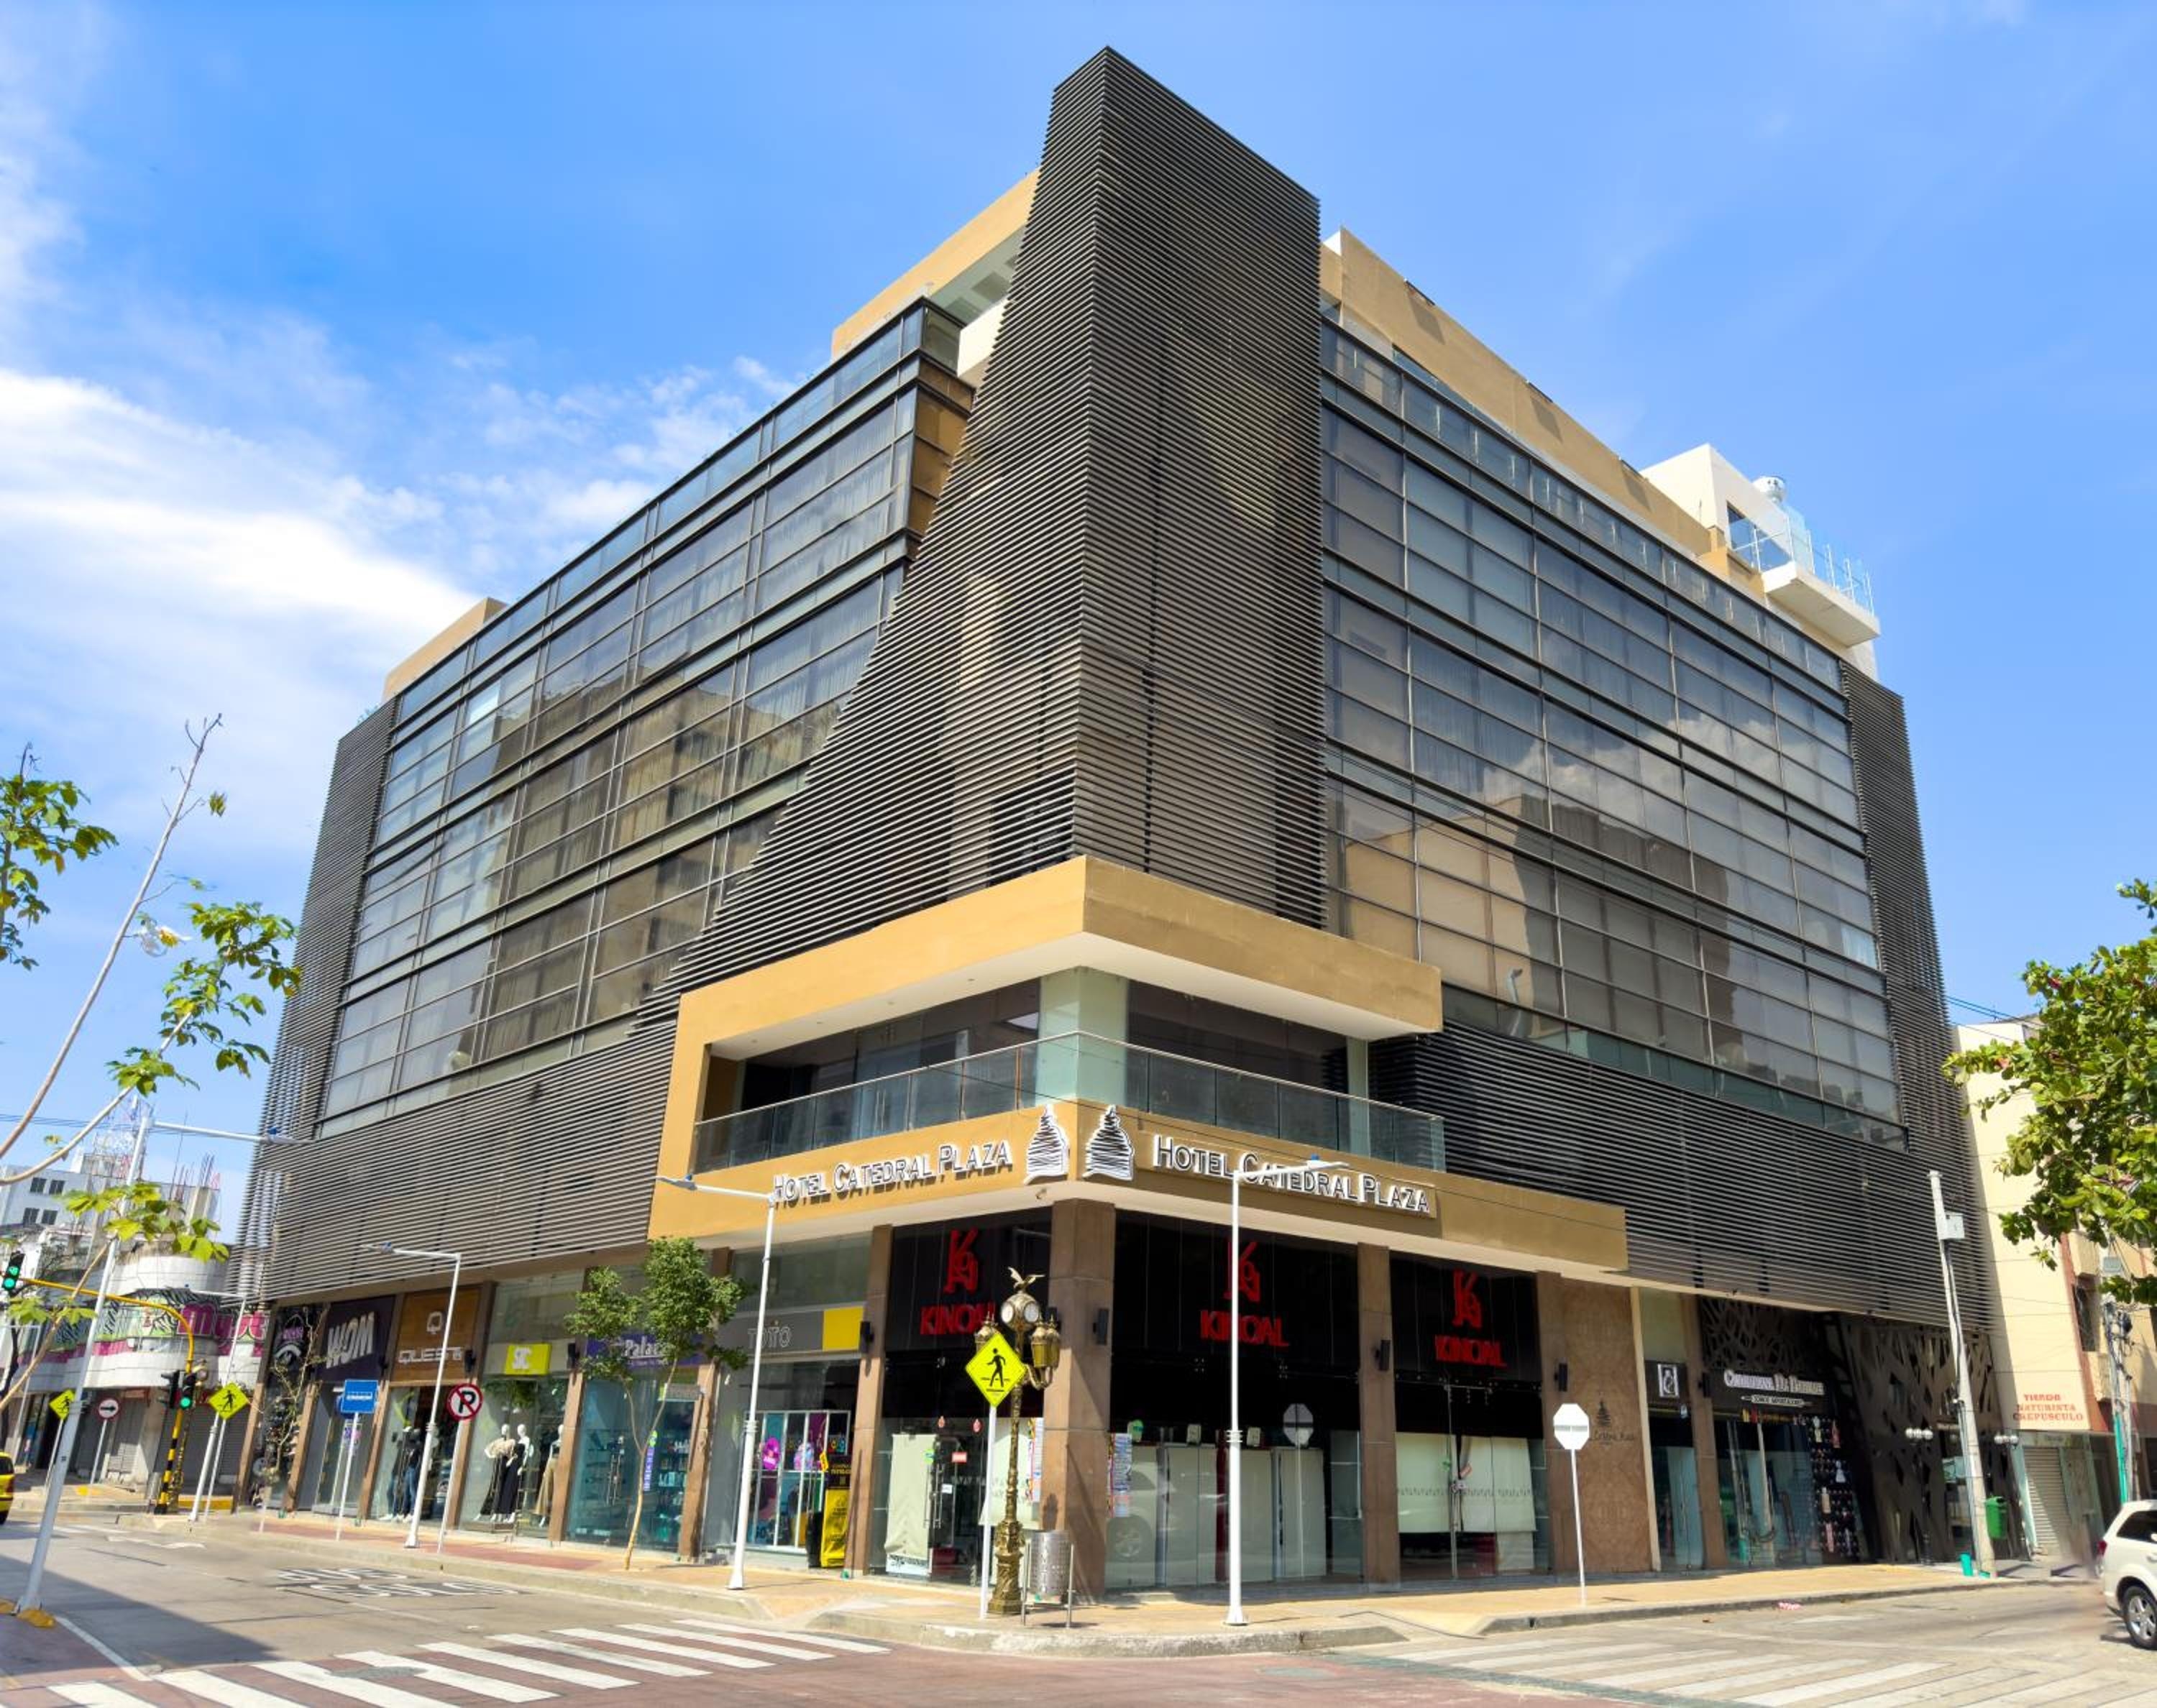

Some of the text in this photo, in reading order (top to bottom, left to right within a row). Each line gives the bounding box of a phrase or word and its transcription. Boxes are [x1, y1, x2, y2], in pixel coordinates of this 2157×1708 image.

[938, 1140, 1013, 1175] PLAZA
[1153, 1134, 1234, 1179] HOTEL
[1358, 1173, 1430, 1214] PLAZA
[326, 1310, 375, 1369] WOM
